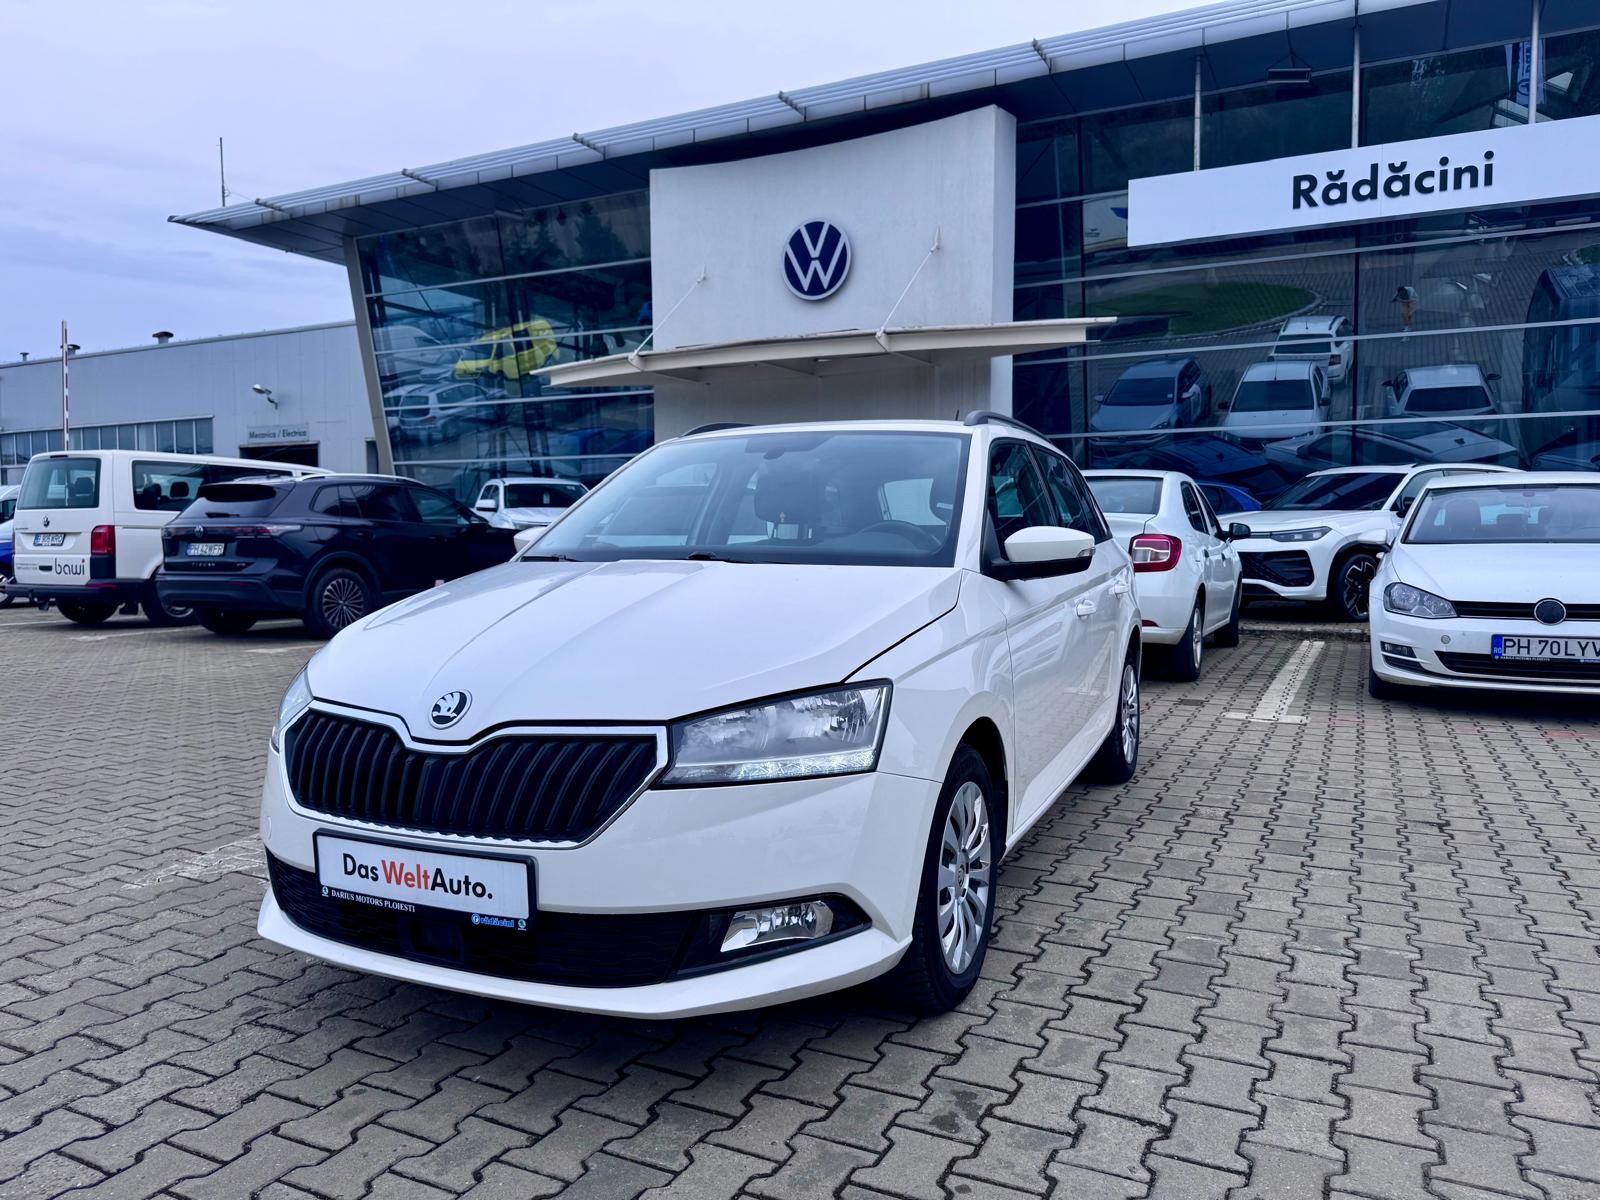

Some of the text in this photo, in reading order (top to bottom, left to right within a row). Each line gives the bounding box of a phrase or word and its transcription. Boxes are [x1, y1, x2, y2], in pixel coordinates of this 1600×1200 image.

[1292, 150, 1495, 209] Rădăcini
[55, 557, 85, 576] bawi
[1503, 638, 1531, 655] PH
[343, 853, 379, 882] Das
[331, 889, 416, 913] DARIUS MOTORS PLOIESTI
